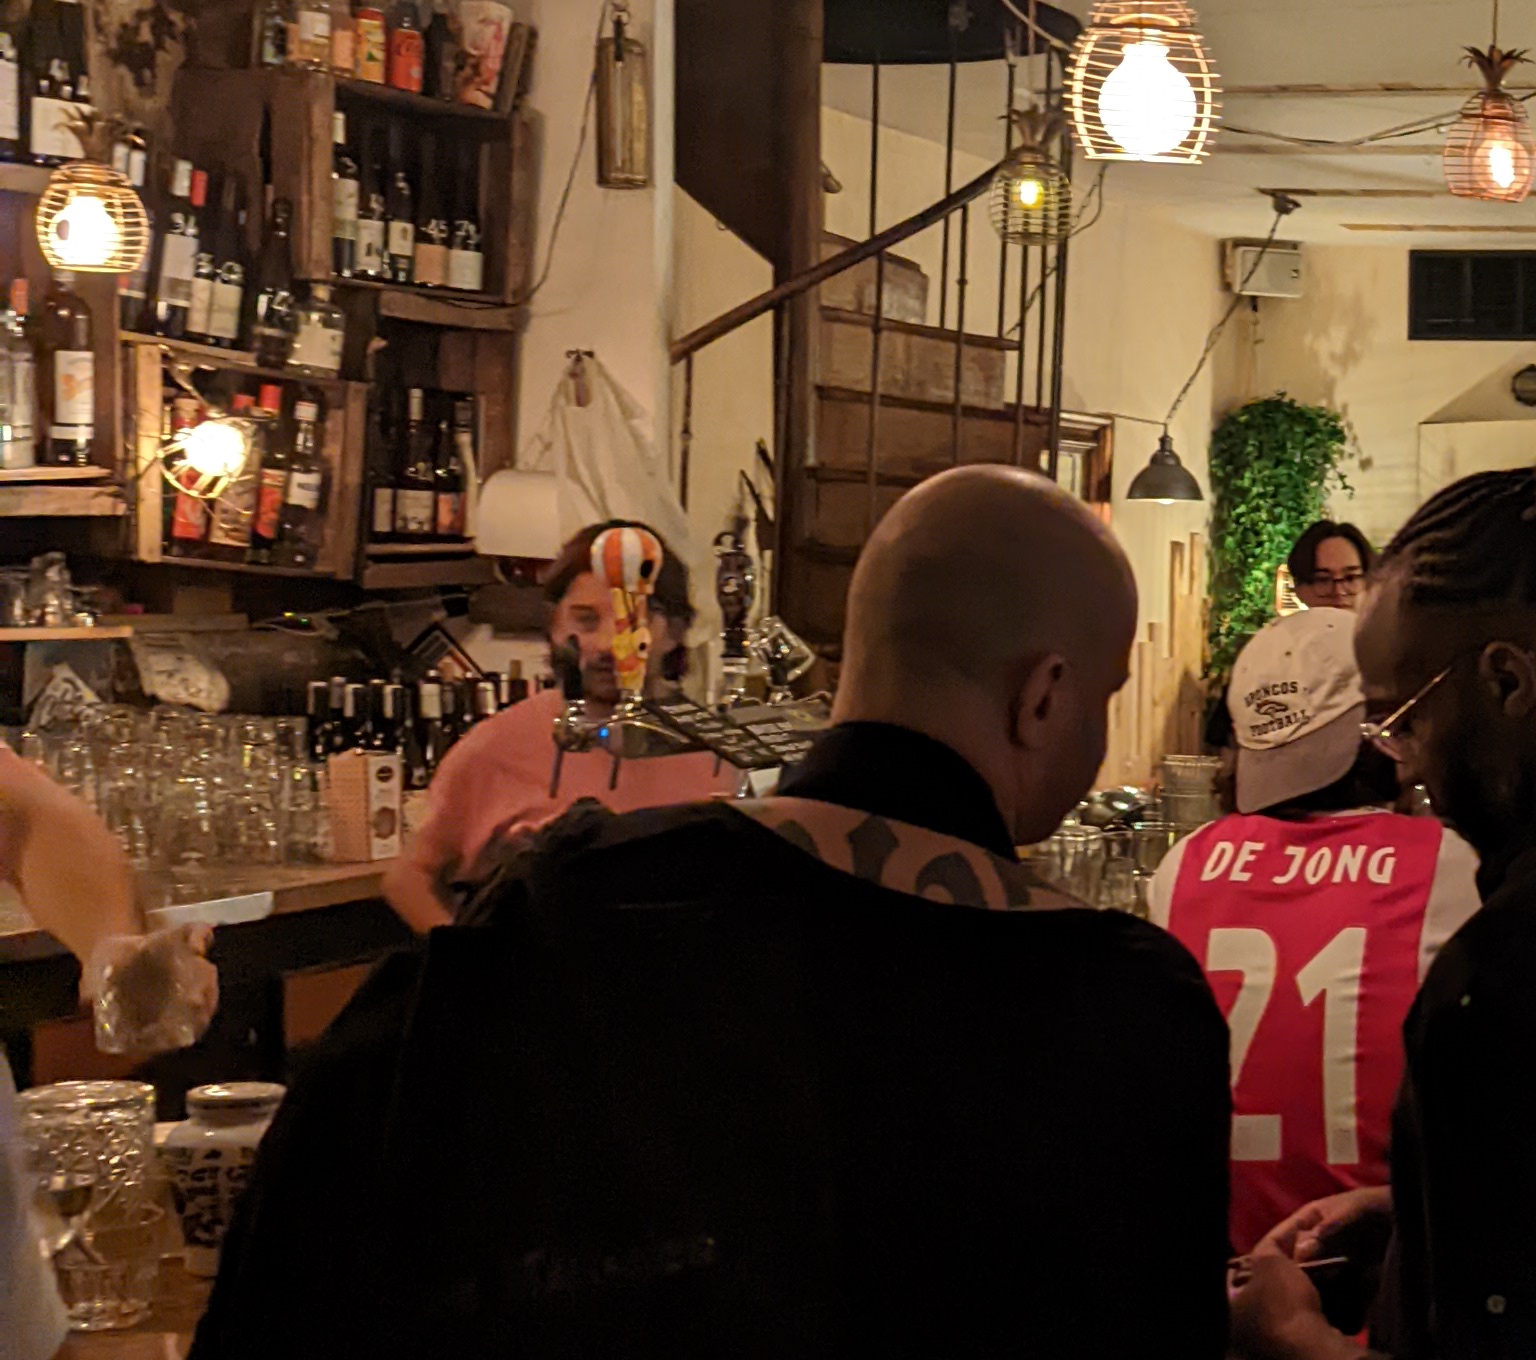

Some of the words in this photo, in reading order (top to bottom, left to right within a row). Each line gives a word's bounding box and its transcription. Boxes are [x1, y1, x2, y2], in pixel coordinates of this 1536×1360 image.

[1244, 681, 1299, 708] BRONCOS
[1201, 841, 1264, 881] DE
[1272, 844, 1396, 885] JONG
[1205, 926, 1367, 1165] 21
